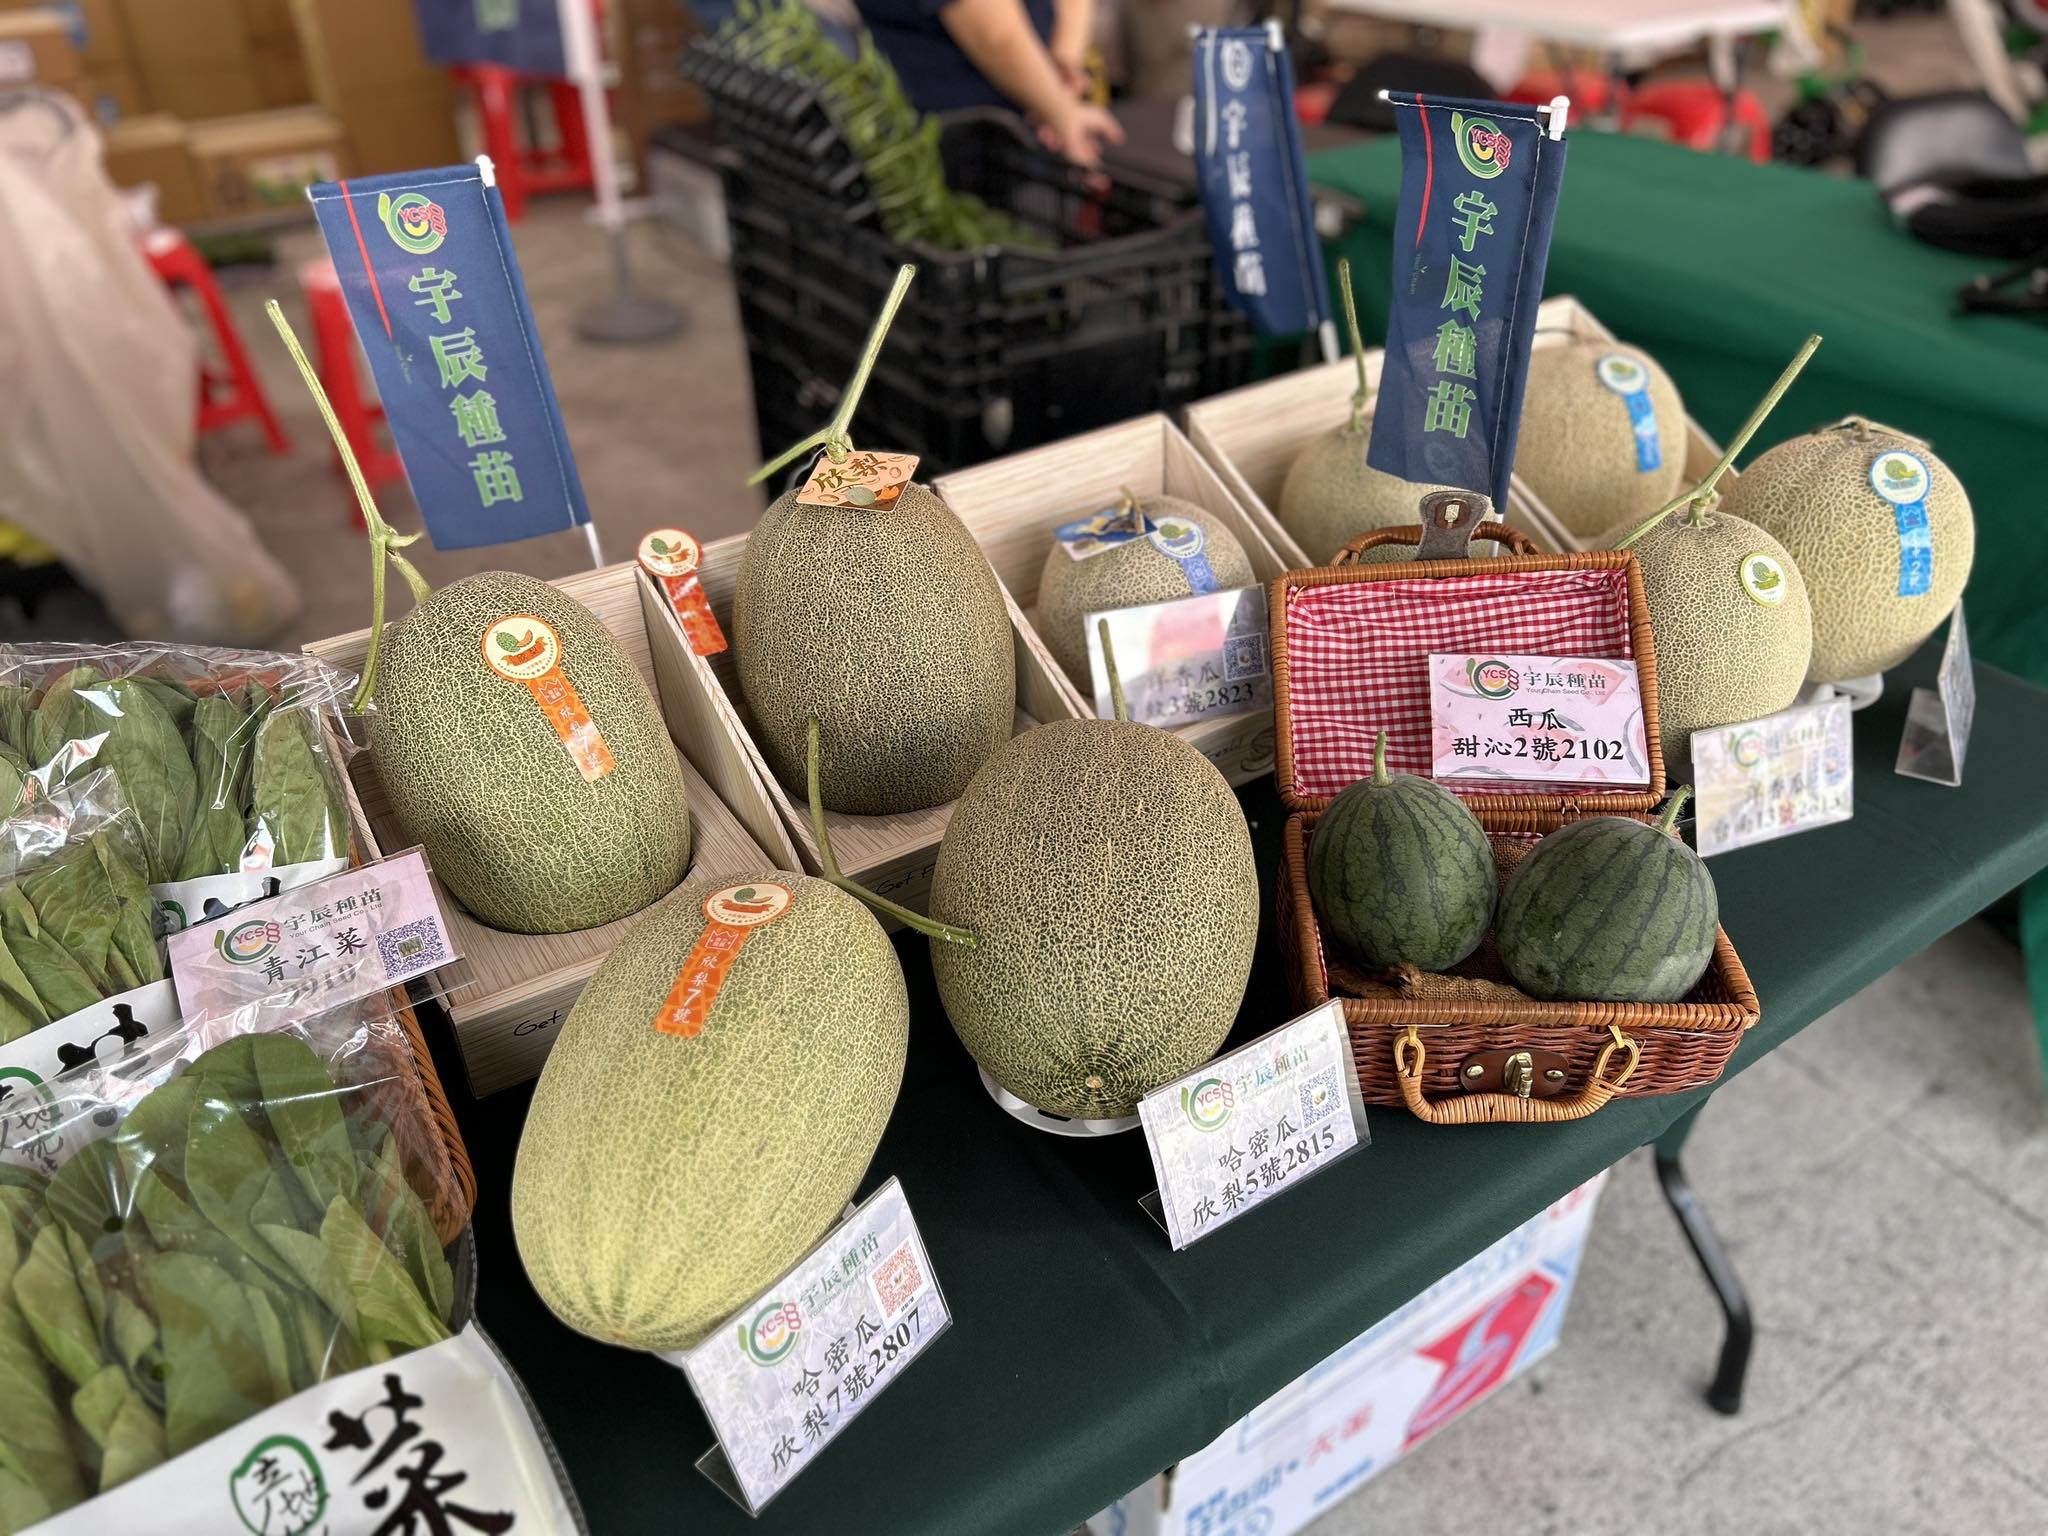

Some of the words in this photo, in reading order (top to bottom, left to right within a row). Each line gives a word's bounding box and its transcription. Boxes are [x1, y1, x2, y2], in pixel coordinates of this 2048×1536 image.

[1423, 190, 1499, 440] 宇辰種苗
[408, 267, 523, 507] 宇辰種苗
[1523, 671, 1606, 689] 宇辰種苗
[1451, 734, 1625, 762] 甜沁2號2102
[1508, 708, 1567, 731] 西瓜
[283, 887, 382, 931] 宇辰種苗
[309, 921, 331, 933] Chain
[332, 913, 352, 924] Seed
[259, 927, 368, 985] 青江菜
[513, 1010, 562, 1037] Get
[1234, 1044, 1309, 1094] 宇辰種苗
[1218, 1114, 1299, 1174] 哈密瓜
[1192, 1124, 1335, 1229] 欣梨5號2815
[799, 1231, 879, 1309] 宇辰種苗
[792, 1313, 882, 1399] 哈密瓜
[770, 1307, 921, 1475] 欣梨7號2807
